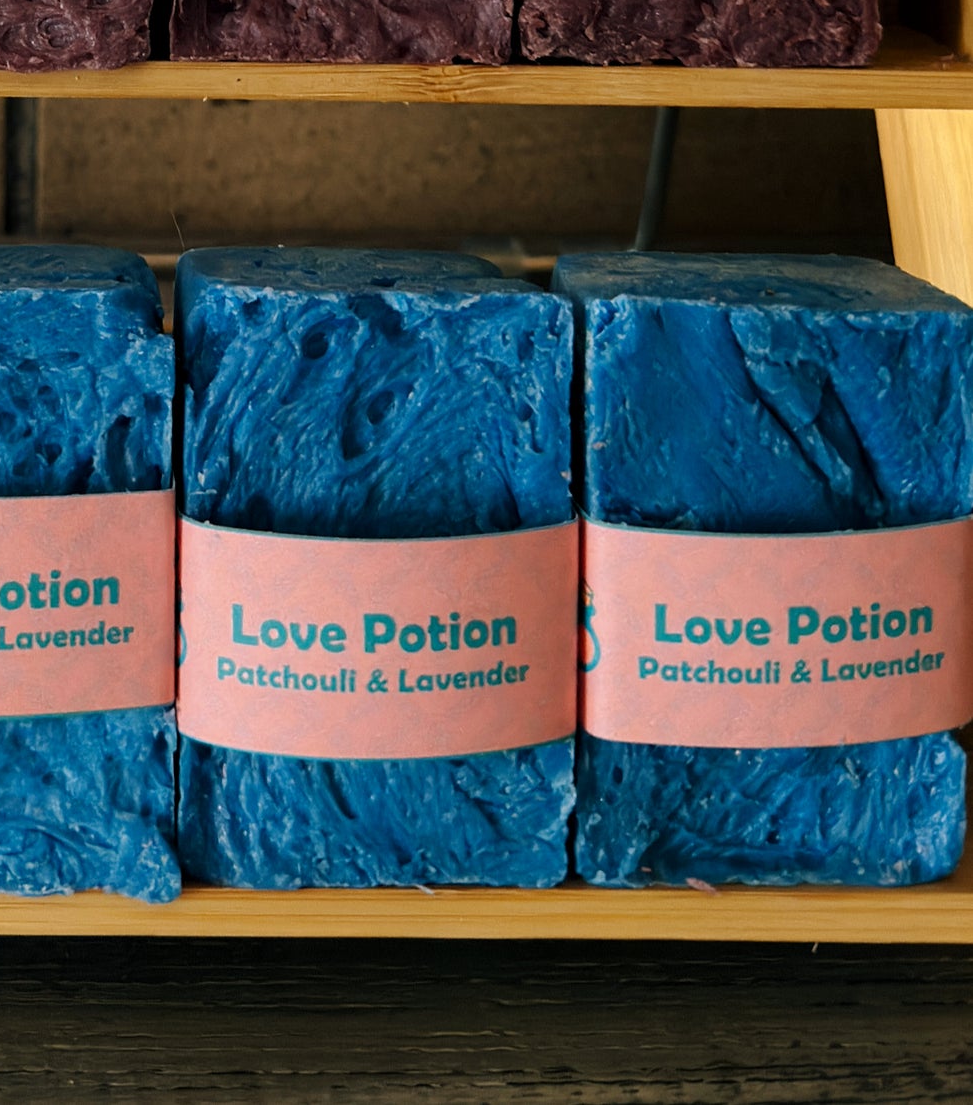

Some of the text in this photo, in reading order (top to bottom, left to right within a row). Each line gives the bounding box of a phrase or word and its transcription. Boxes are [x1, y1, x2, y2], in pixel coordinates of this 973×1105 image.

[230, 602, 517, 655] Love Potion
[653, 602, 934, 648] Love Potion
[216, 655, 530, 695] Patchouli & Lavender
[637, 649, 945, 686] Patchouli & Lavender
